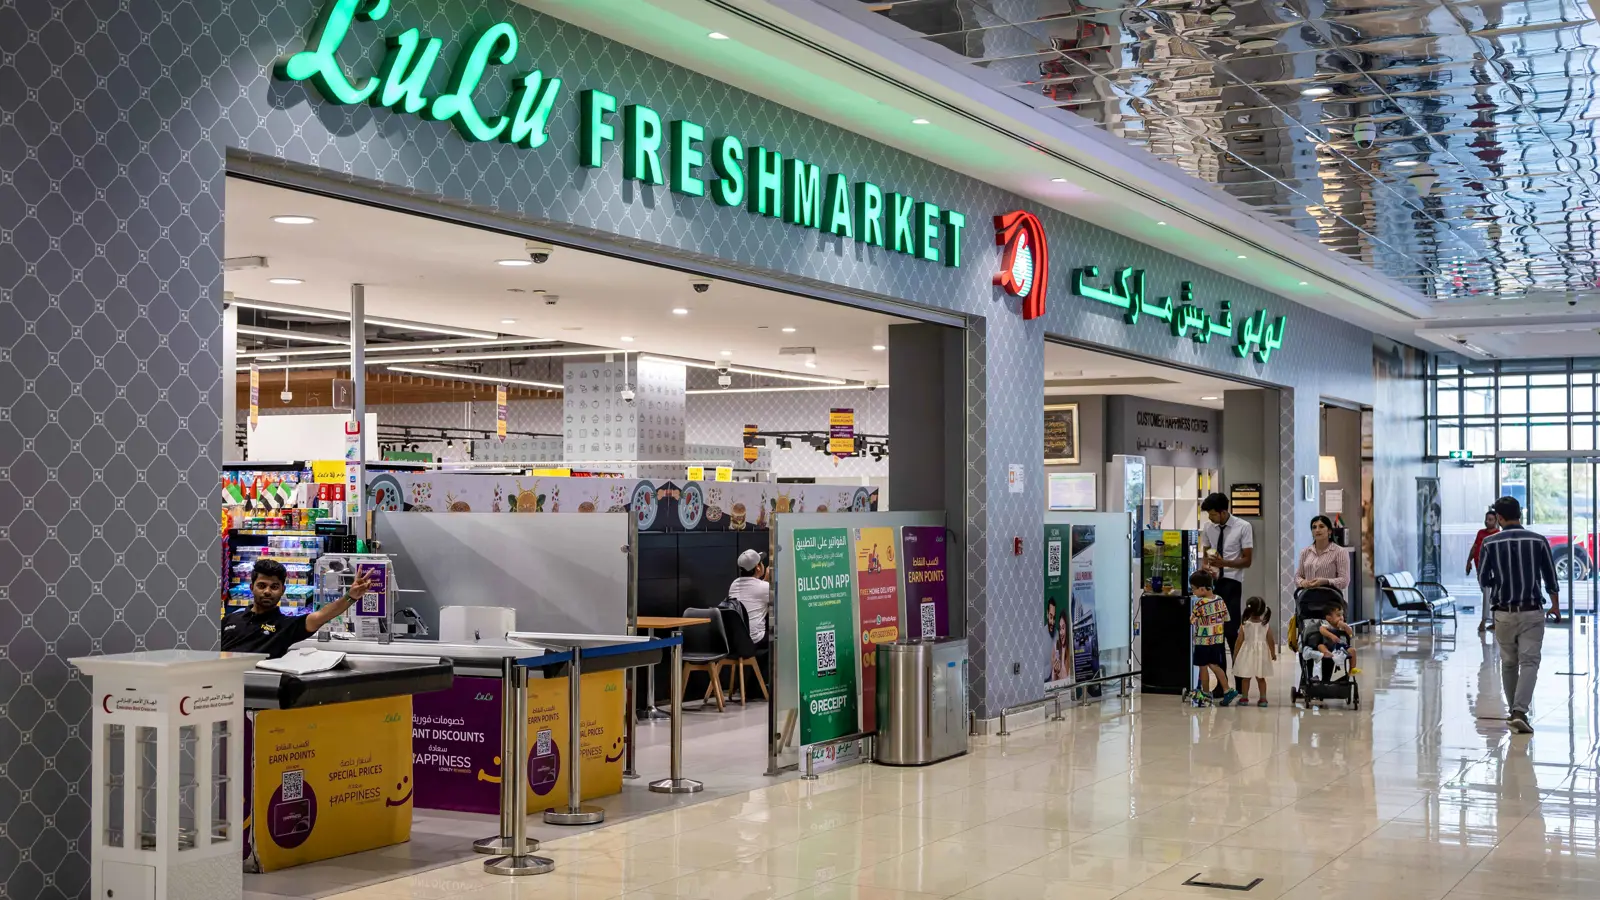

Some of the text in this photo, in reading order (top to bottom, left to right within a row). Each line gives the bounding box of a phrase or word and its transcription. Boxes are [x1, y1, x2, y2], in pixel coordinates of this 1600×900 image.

[276, 0, 966, 268] LuLu FRESHMARKET
[1072, 265, 1286, 363] لولو فريش ماركت
[1136, 410, 1208, 433] CUSTOMER HAPPINESS CENTER
[795, 536, 846, 551] الفواتير على التطبيق
[798, 574, 850, 592] BILLS ON APP
[908, 570, 944, 583] EARN POINTS
[474, 692, 494, 700] LuLu
[818, 694, 847, 712] RECEIPT
[383, 712, 401, 722] LuLu
[433, 716, 464, 726] خصومات
[542, 713, 560, 722] POINTS
[412, 728, 484, 743] ANT DISCOUNTS
[588, 727, 604, 736] PRICES
[269, 749, 315, 765] EARN POINTS
[329, 764, 382, 781] SPECIAL PRICES
[329, 787, 380, 807] HAPPINESS
